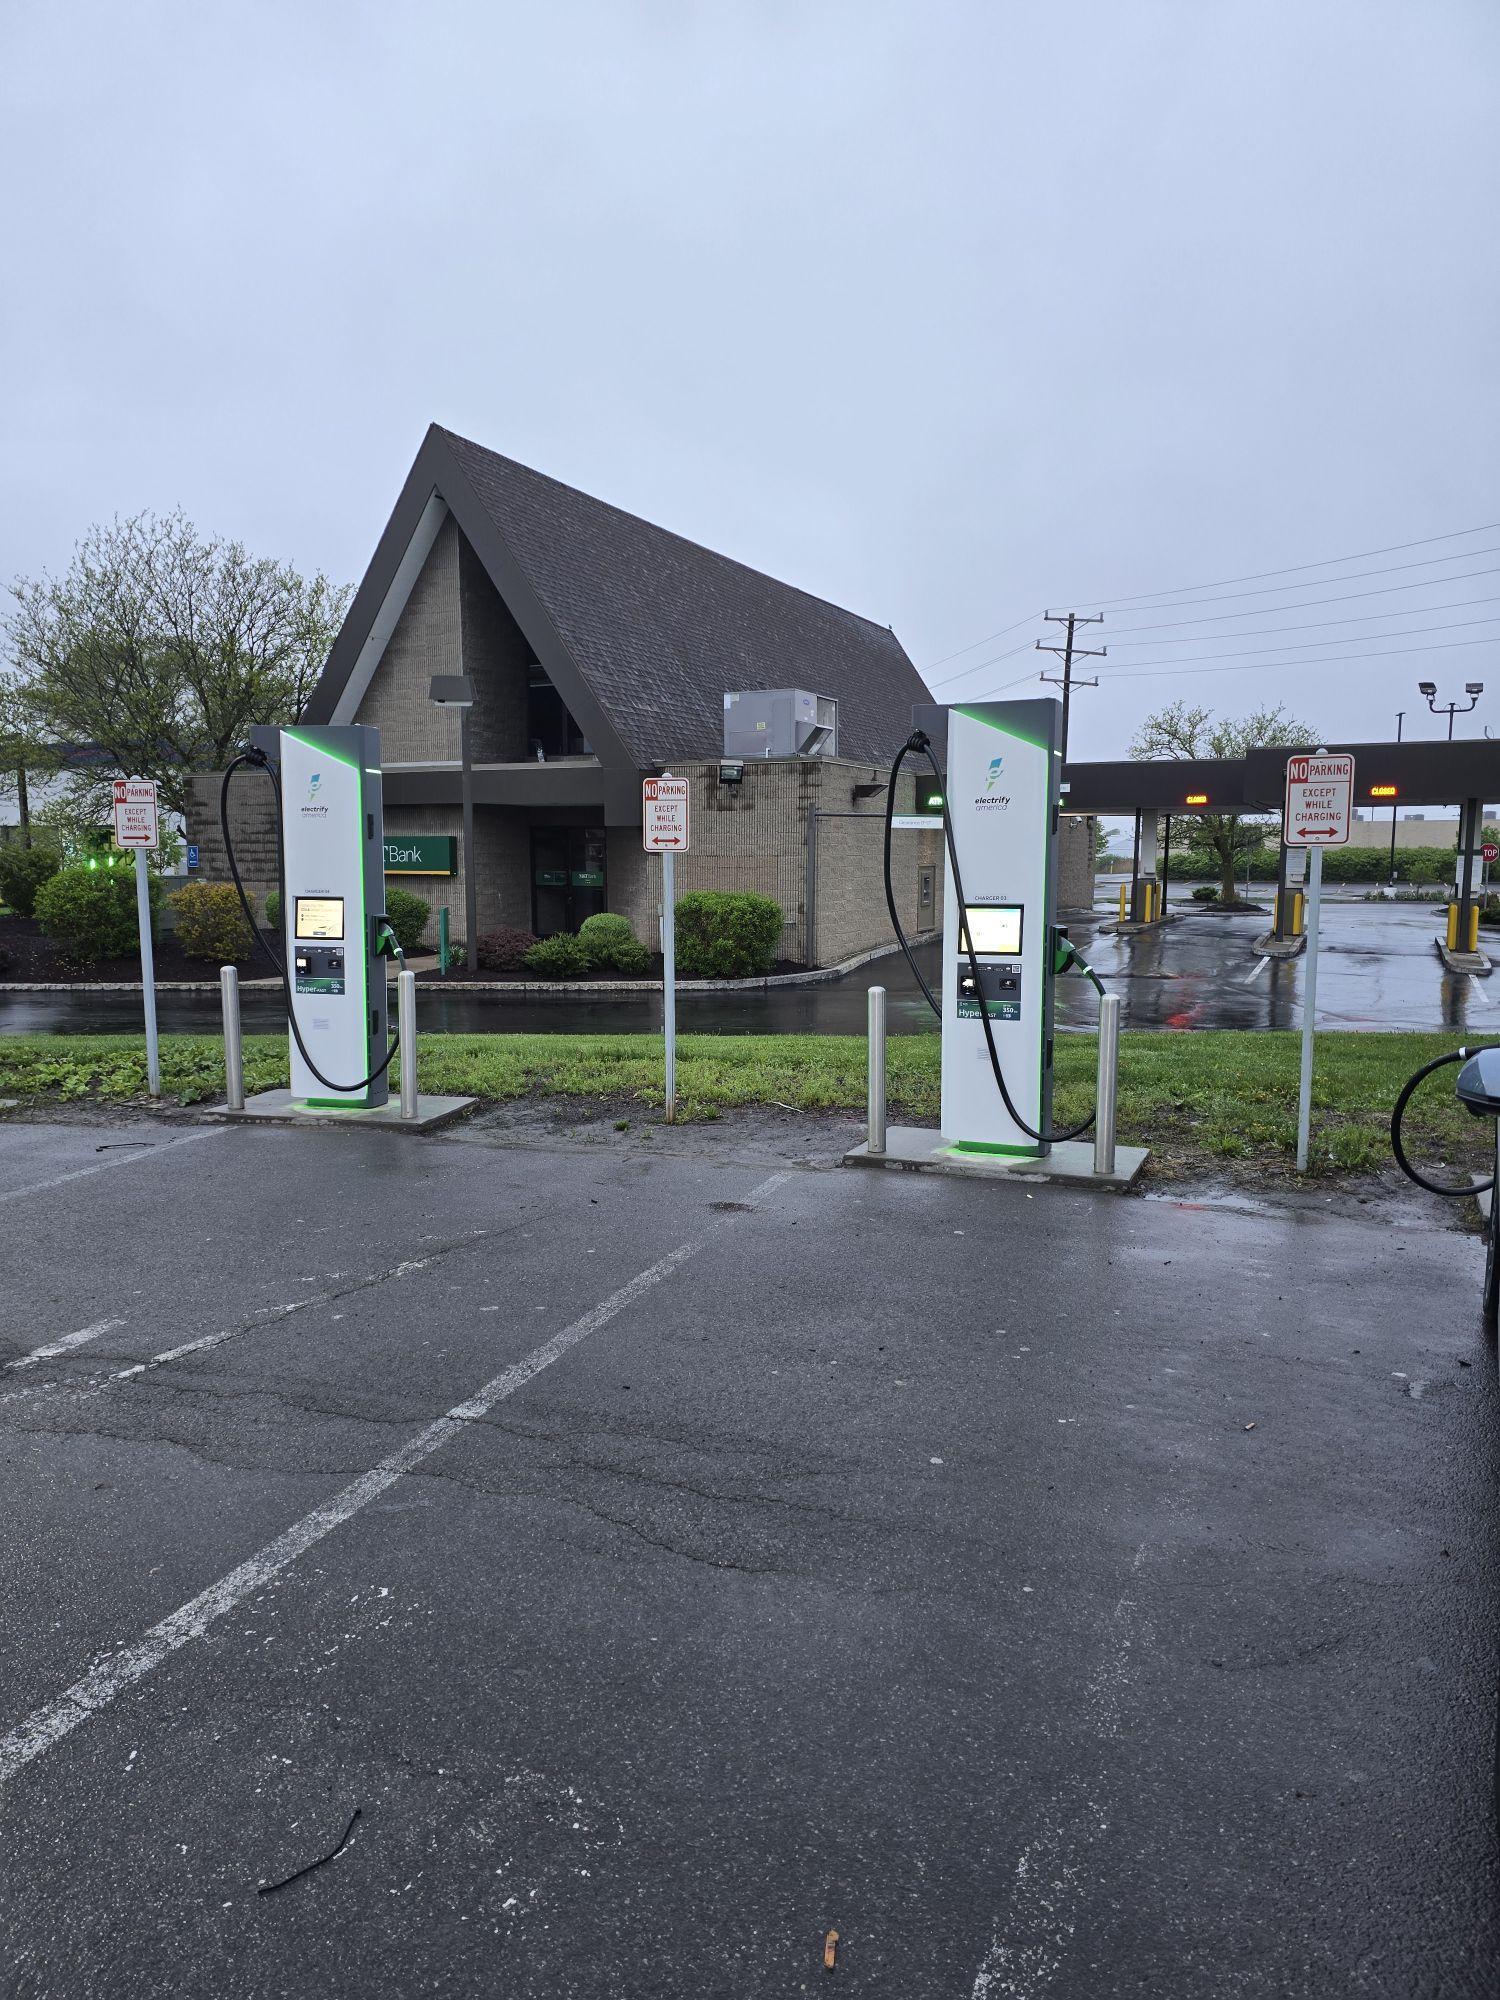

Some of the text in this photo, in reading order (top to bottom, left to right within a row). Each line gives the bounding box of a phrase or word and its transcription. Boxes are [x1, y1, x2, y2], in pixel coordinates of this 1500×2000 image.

[1290, 762, 1349, 780] NO PARKING
[114, 786, 153, 799] NO PARKING
[645, 783, 686, 798] NO PARKING
[1302, 788, 1337, 798] EXCEPT
[1371, 786, 1395, 796] CLOSED
[974, 796, 1011, 805] electrify
[1186, 795, 1207, 804] CLOSED
[654, 805, 678, 813] EXCEPT
[1305, 800, 1333, 809] WHILE
[301, 805, 329, 814] electrify
[1295, 812, 1342, 822] CHARGING
[121, 824, 152, 832] CHARGING
[650, 824, 683, 832] CHARGING
[1483, 849, 1498, 857] TOP
